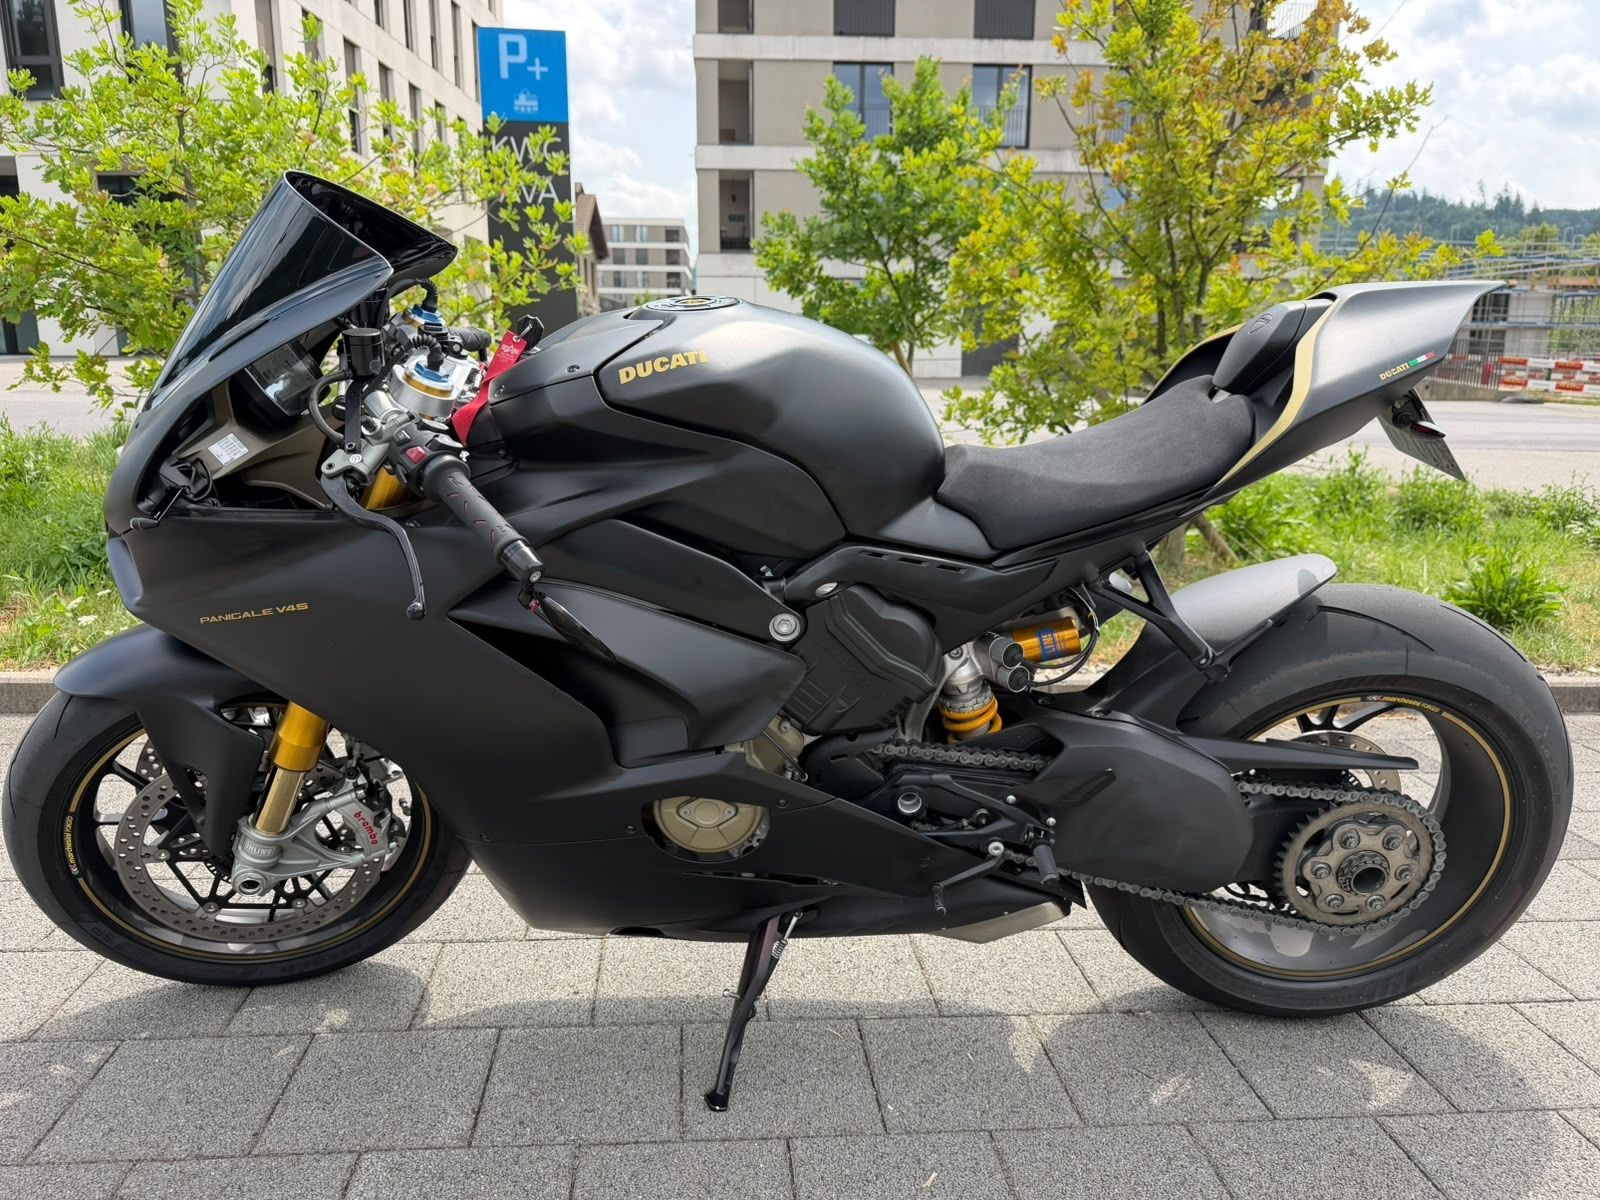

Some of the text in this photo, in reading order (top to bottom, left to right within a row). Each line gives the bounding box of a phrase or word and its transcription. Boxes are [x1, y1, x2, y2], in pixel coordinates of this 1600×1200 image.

[618, 350, 709, 385] DUCATI
[1379, 362, 1410, 381] DUCATI
[199, 602, 309, 625] PANIGALE V4S
[353, 810, 379, 846] brembo
